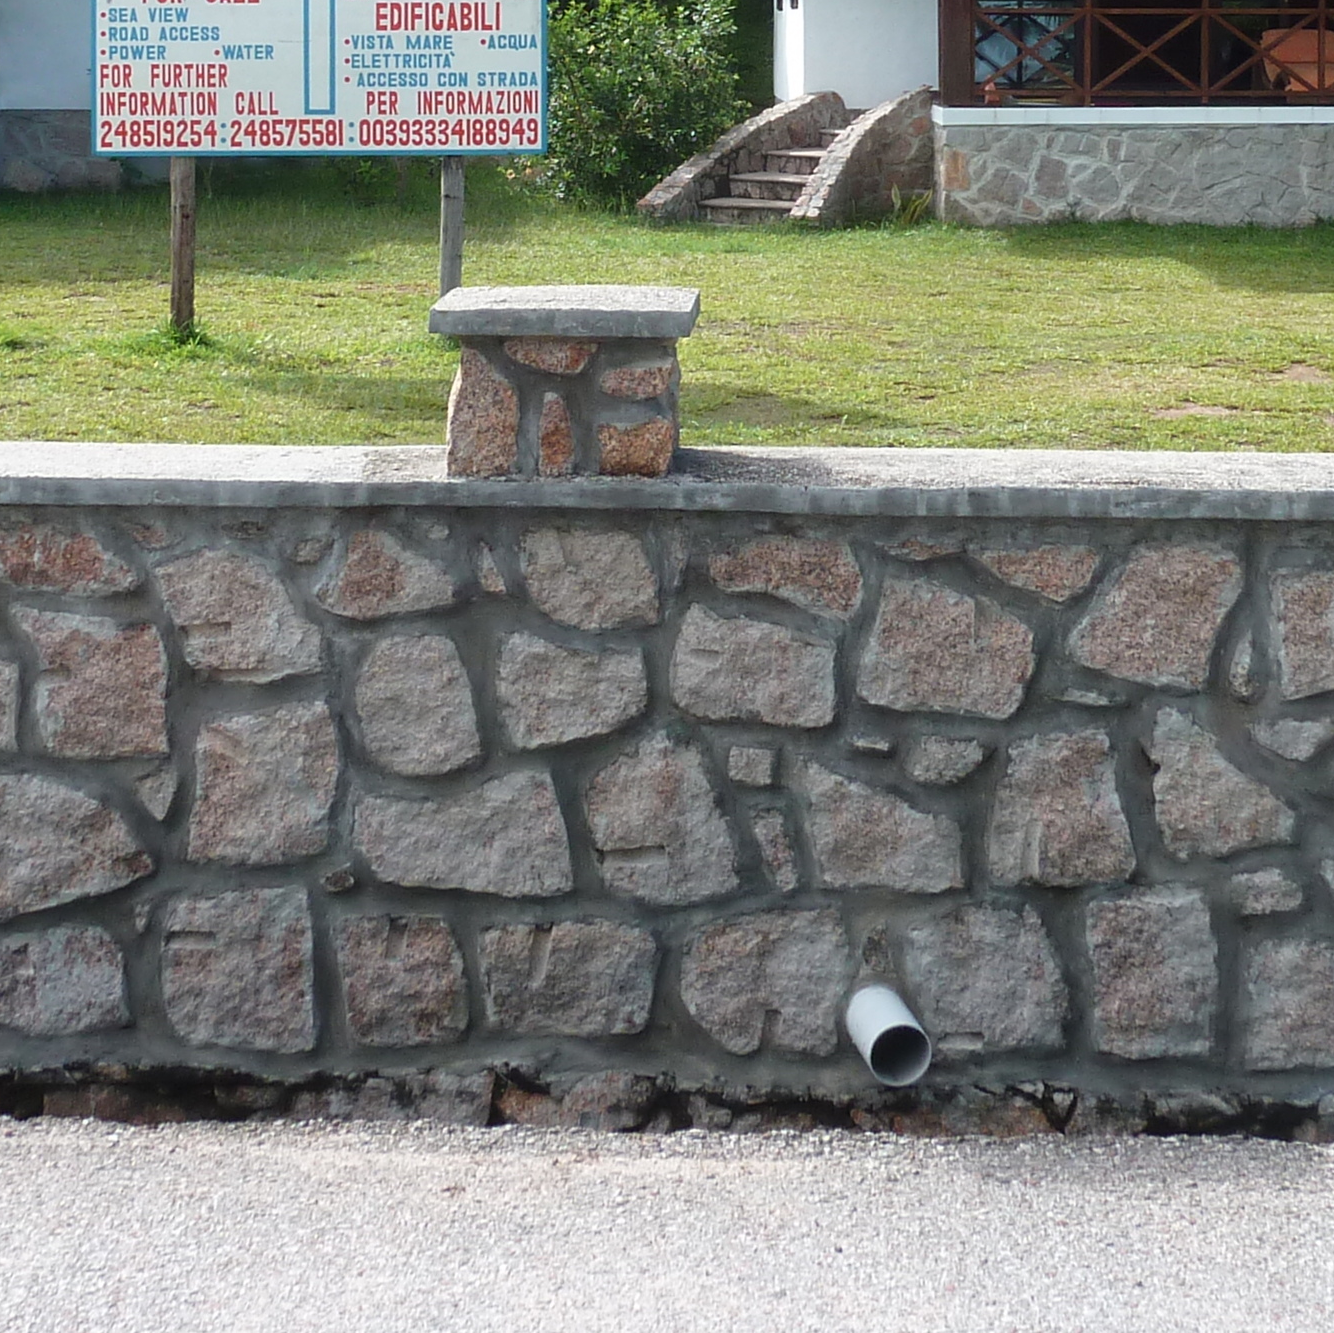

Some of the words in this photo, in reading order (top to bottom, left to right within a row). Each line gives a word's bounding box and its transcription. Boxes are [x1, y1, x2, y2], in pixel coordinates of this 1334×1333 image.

[108, 8, 138, 23] SEA
[148, 7, 189, 23] VIEW
[375, 2, 501, 31] EDIFICABILI
[108, 26, 149, 41] ROAD
[159, 26, 220, 41] ACCESS
[351, 35, 394, 50] VISTA
[406, 35, 453, 50] MARE
[487, 35, 538, 50] ACQUA
[109, 45, 167, 60] POWER
[222, 44, 274, 60] WATER
[100, 64, 132, 88] FOR
[150, 64, 228, 88] FURTHER
[357, 72, 429, 88] ACCESSO
[437, 72, 468, 87] CON
[477, 72, 538, 87] STRADA
[100, 92, 217, 116] INFORMATION
[235, 91, 279, 116] CALL
[366, 91, 399, 115] PER
[417, 91, 539, 115] INFORMAZIONI
